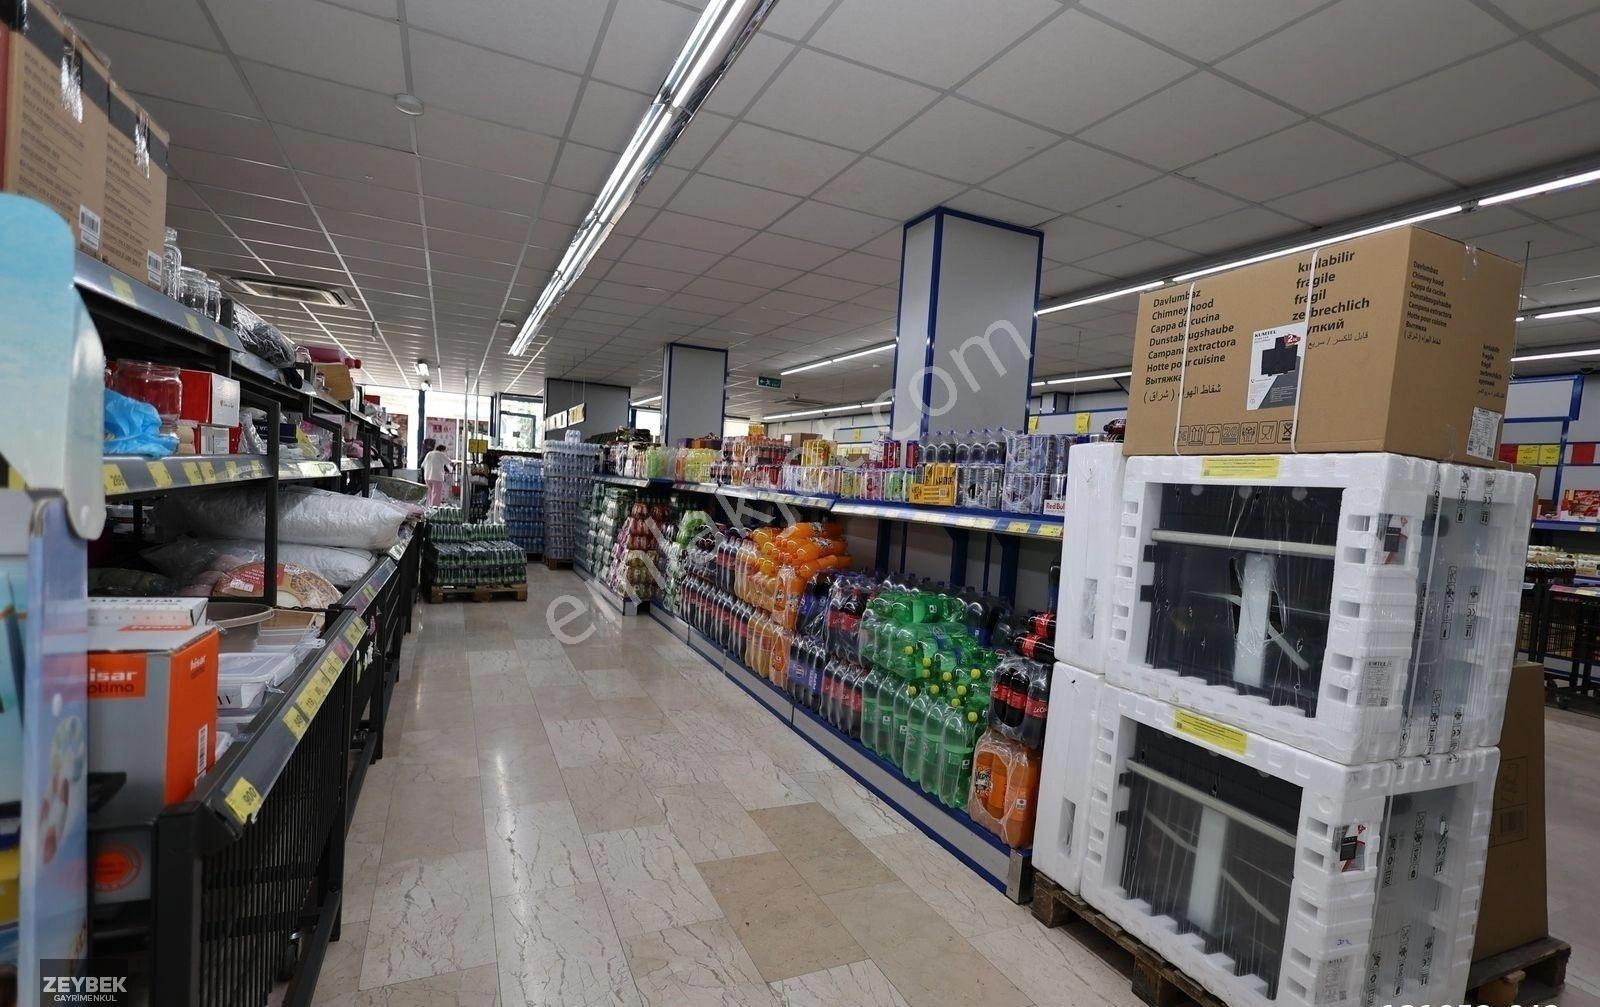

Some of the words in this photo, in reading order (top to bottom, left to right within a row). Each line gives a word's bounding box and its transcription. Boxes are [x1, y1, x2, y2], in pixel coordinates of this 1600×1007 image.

[1153, 290, 1201, 307] Davlumbaz
[1152, 306, 1189, 321] Chimney
[1190, 298, 1214, 312] hood
[1292, 298, 1370, 320] zebrechlich
[1150, 323, 1176, 334] Cappa
[1190, 313, 1220, 325] cucina
[1307, 319, 1344, 336] упкий
[1149, 324, 1234, 347] Dunstabugshaube
[1148, 347, 1185, 359] Campana
[1188, 339, 1236, 353] extractora
[1147, 363, 1169, 373] Hotte
[1193, 354, 1226, 366] cuisine
[1145, 374, 1182, 386] Вытяжка
[1046, 502, 1055, 510] Red
[89, 667, 138, 681] isar
